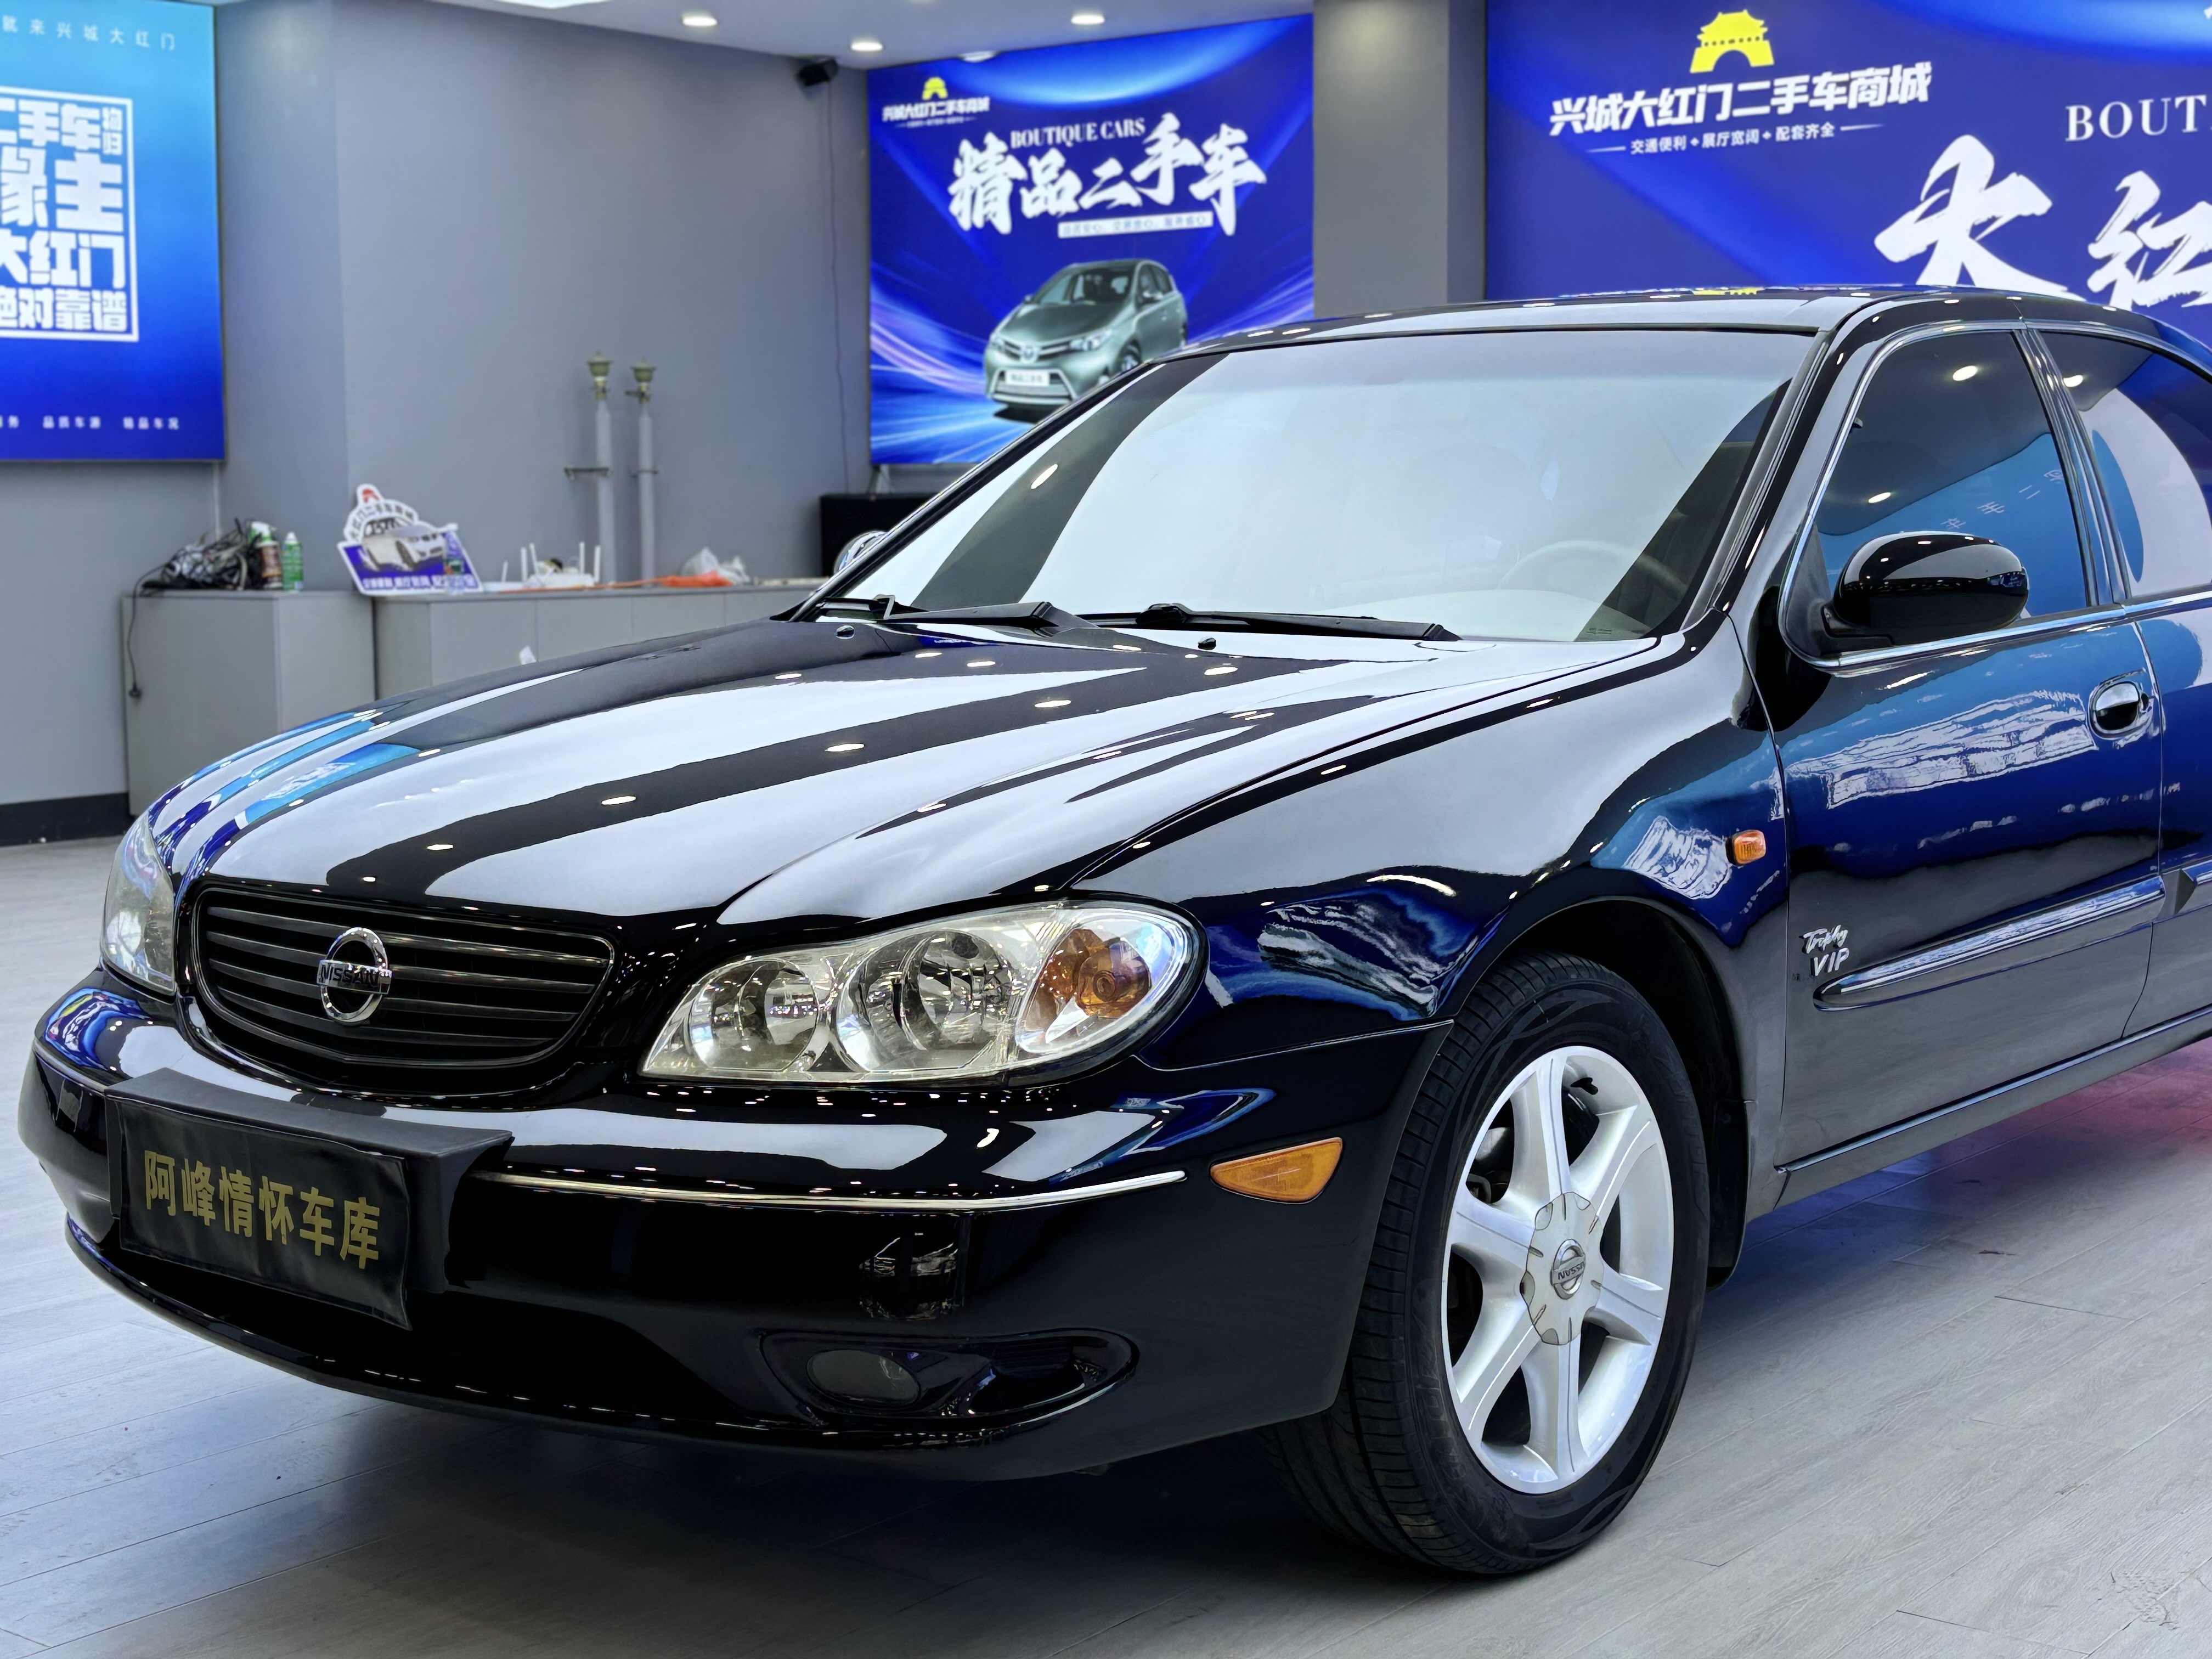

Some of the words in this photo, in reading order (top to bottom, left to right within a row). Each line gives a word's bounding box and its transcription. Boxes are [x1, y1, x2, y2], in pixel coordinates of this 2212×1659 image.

[1549, 61, 1933, 137] 兴城大红门二手车商城
[2065, 94, 2212, 142] BOUT
[1011, 122, 1098, 149] BOUTIQUE
[1100, 117, 1146, 139] CARS
[1630, 135, 1686, 155] 交通便利
[1775, 122, 1835, 142] 配套齐全
[947, 112, 1266, 236] 精品二手车
[318, 963, 380, 987] NISSAN
[1813, 947, 1849, 977] VIP
[144, 1150, 381, 1269] 阿峰情怀车库
